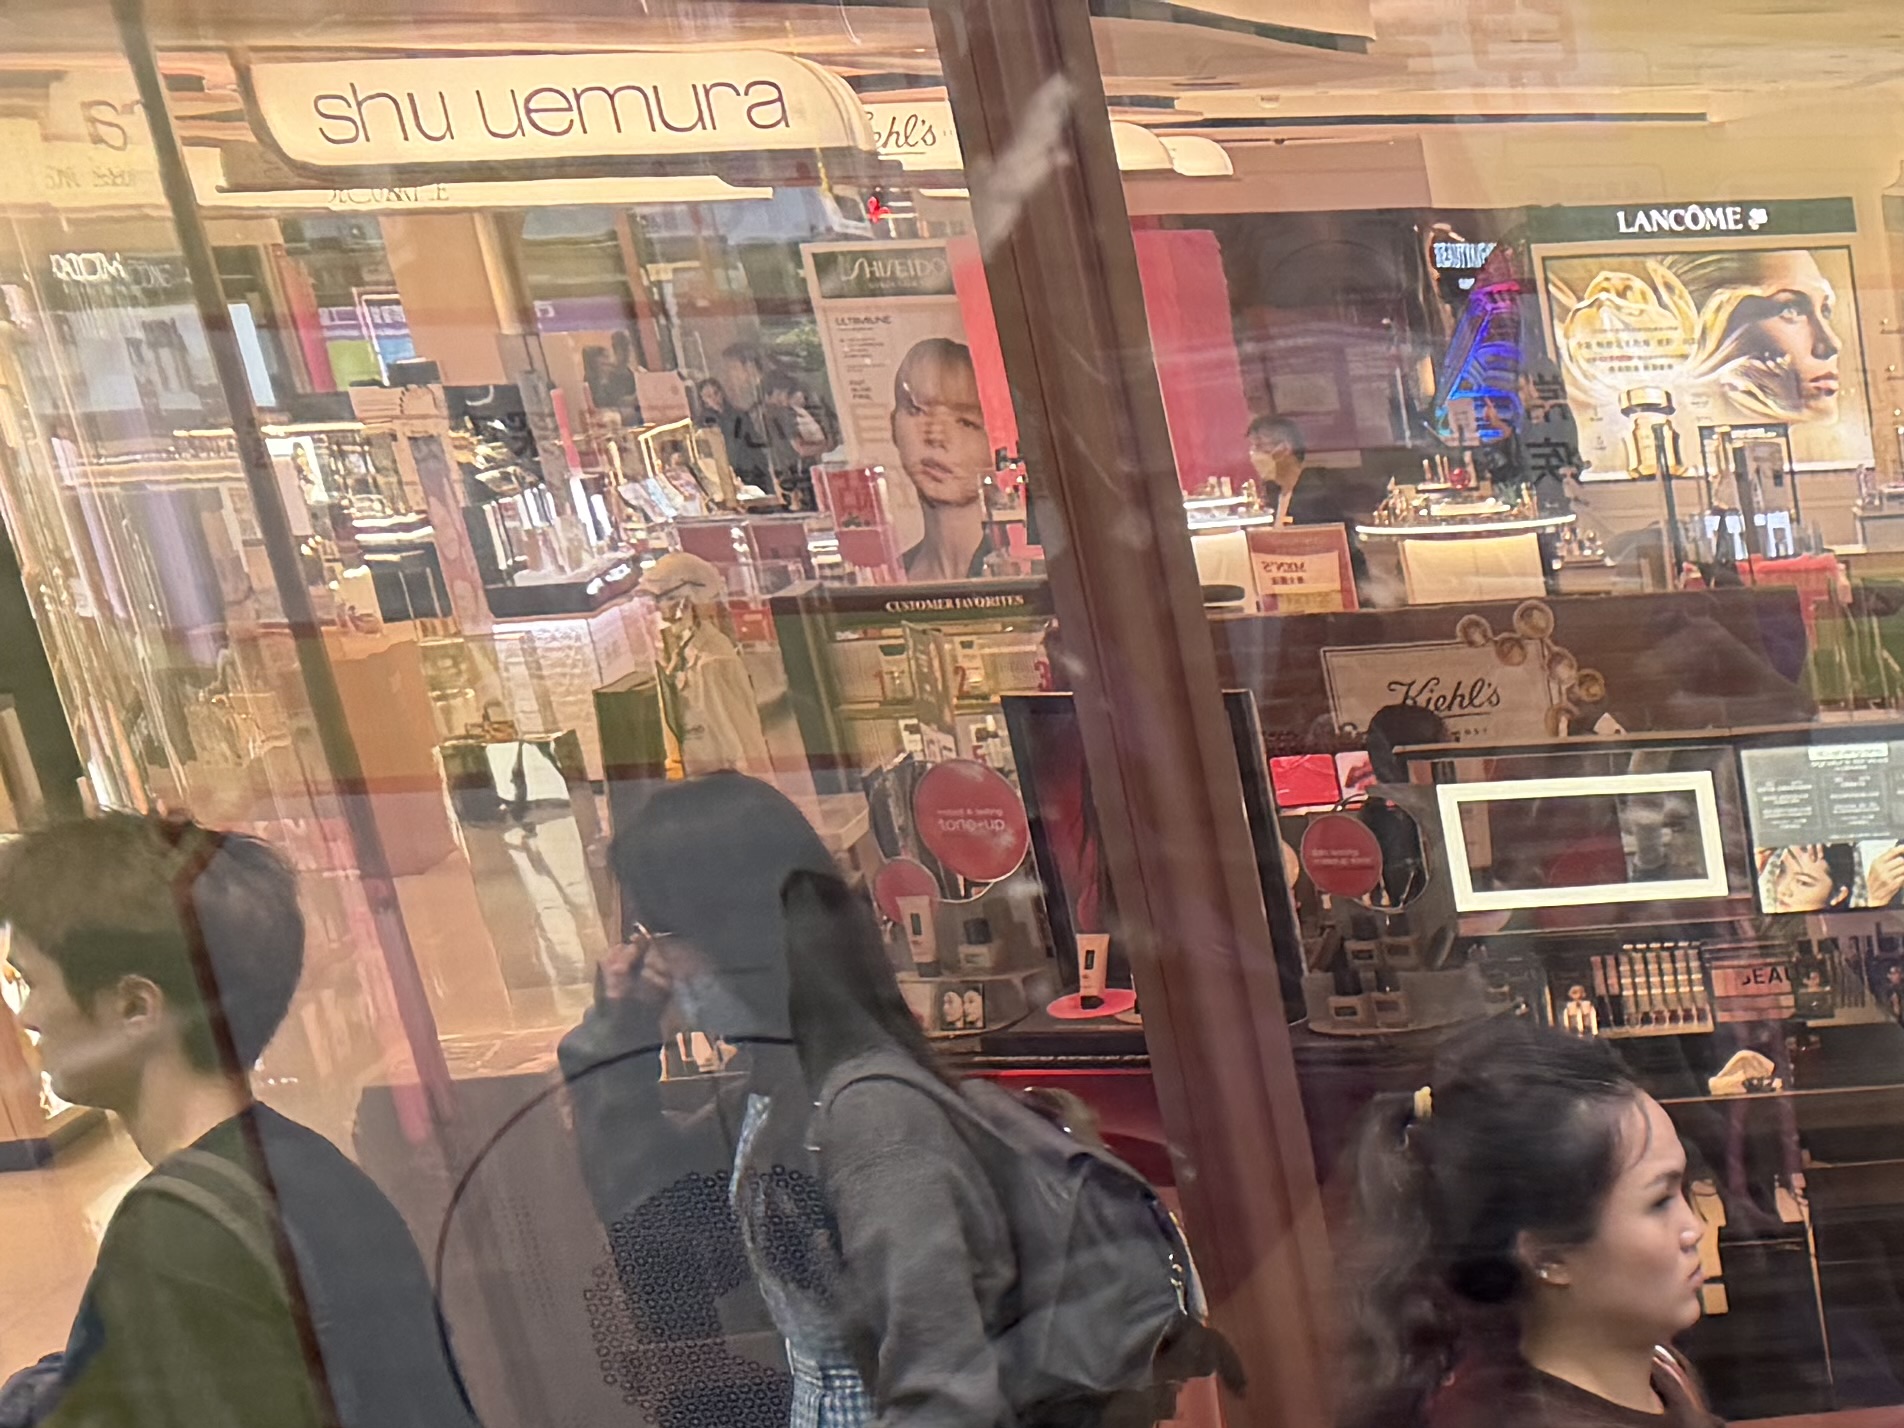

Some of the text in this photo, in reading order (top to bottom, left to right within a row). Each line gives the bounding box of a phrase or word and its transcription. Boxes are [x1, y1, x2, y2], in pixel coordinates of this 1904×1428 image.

[313, 72, 794, 146] shu uemura
[1616, 203, 1744, 234] LANCÔME
[885, 594, 1025, 613] CUSTOMER FAVORITES
[954, 665, 970, 695] 2
[1034, 659, 1052, 692] 3
[1386, 676, 1501, 714] Kiehl's
